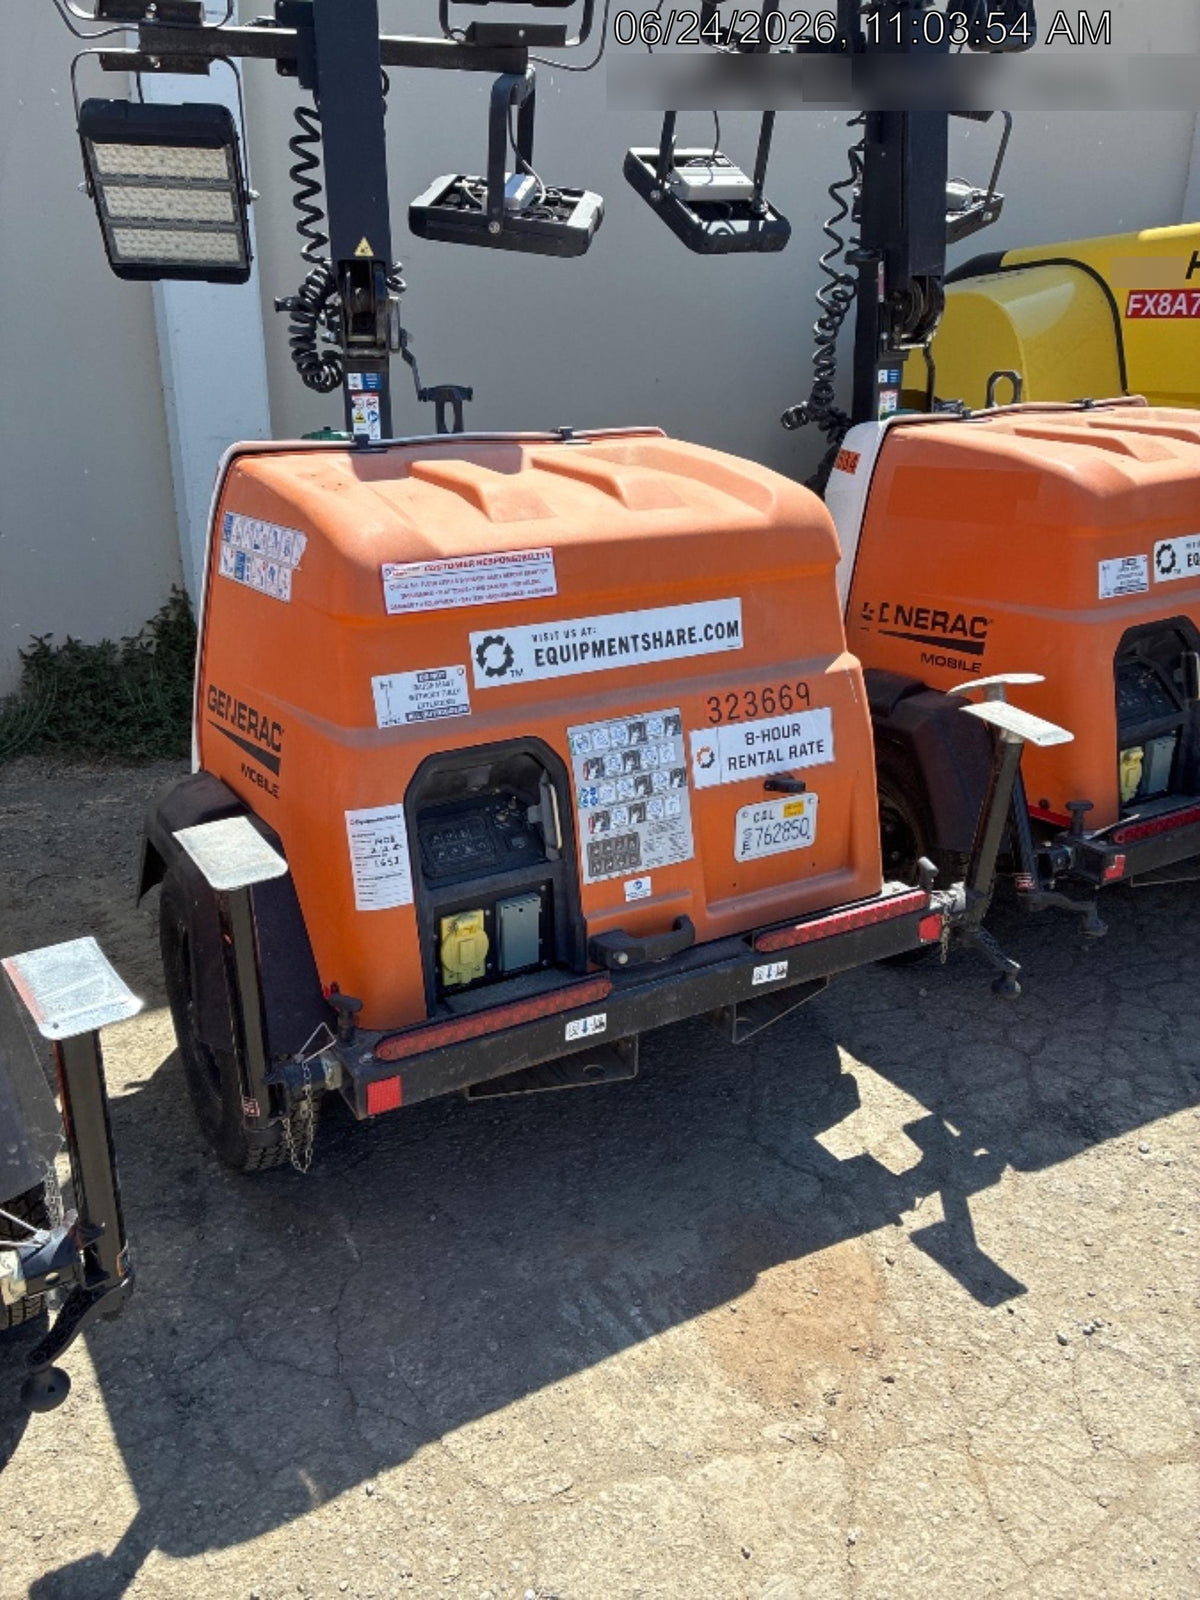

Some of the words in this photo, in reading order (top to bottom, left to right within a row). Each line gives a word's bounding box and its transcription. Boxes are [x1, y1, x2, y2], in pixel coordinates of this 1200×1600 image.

[532, 629, 560, 643] VISIT
[564, 628, 577, 640] US
[581, 626, 597, 638] AT:
[534, 619, 740, 667] EQUIPMENTSHARE.COM
[920, 653, 982, 674] MOBILE
[707, 682, 810, 724] 323669
[745, 723, 801, 746] 8-HOUR
[728, 748, 784, 771] RENTAL
[789, 739, 825, 760] RATE
[241, 763, 280, 799] MOBILE
[753, 810, 775, 824] CAL
[755, 817, 810, 849] 762850
